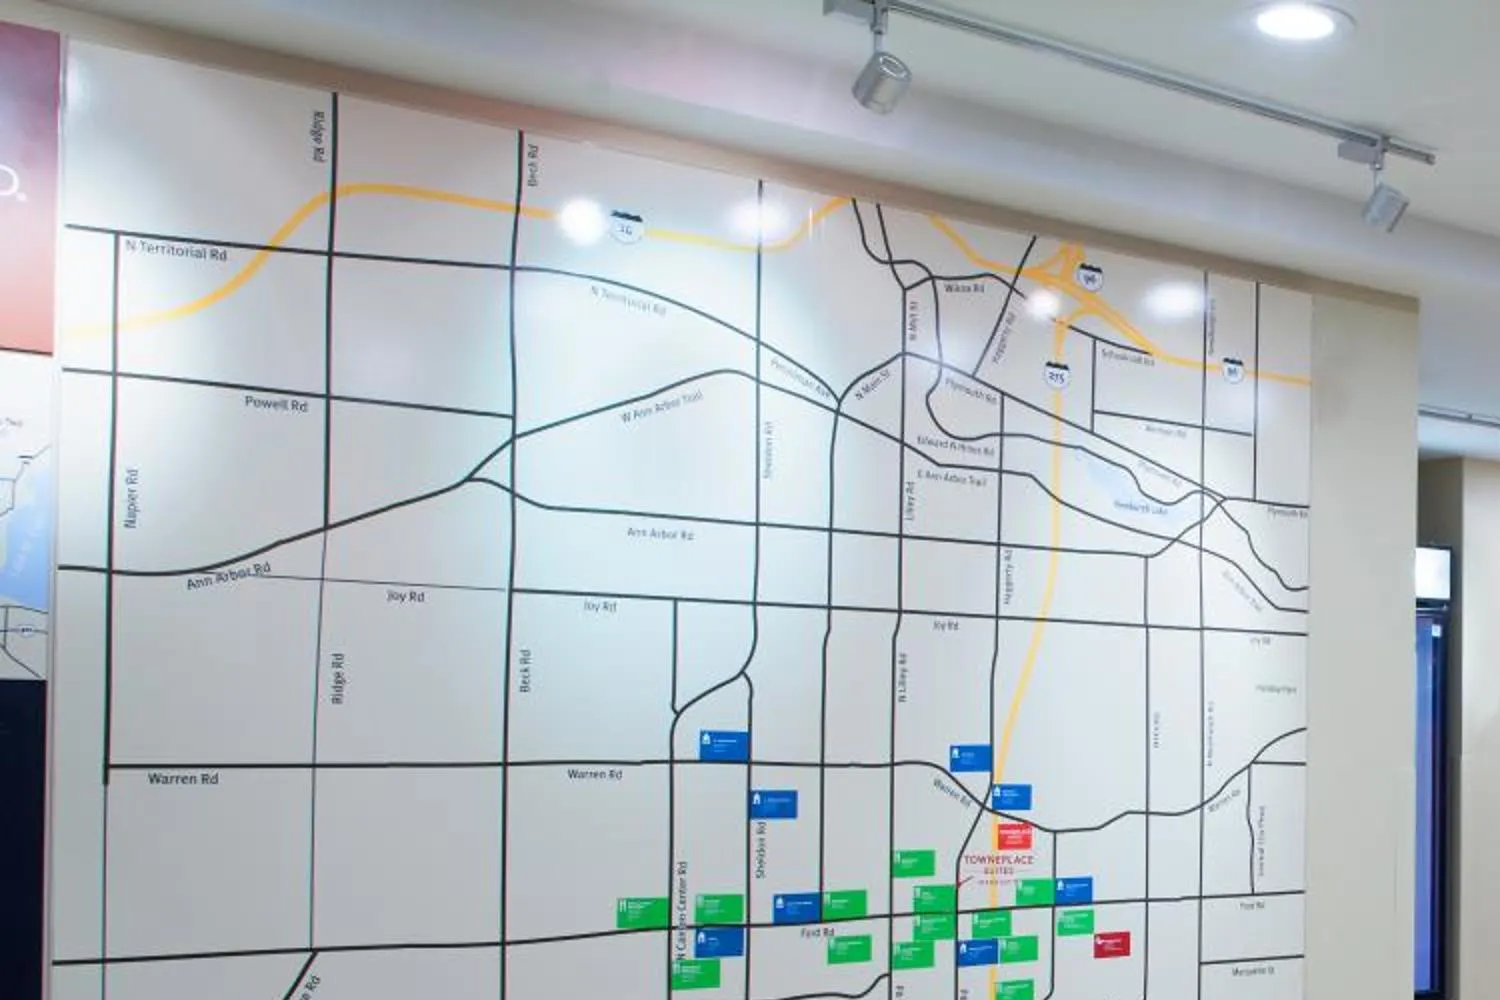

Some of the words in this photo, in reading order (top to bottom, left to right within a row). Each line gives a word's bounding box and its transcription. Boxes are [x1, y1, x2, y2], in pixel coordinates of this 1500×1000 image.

[126, 240, 136, 252] N
[140, 241, 207, 260] Territorial
[210, 249, 227, 262] Rd
[245, 396, 288, 411] Powell
[290, 400, 308, 413] Rd
[128, 469, 138, 485] Rd
[124, 486, 138, 529] Napier
[627, 527, 648, 538] Ann
[649, 528, 678, 540] Arbor
[187, 576, 213, 591] Ann
[215, 566, 251, 586] Arbor
[253, 562, 271, 577] Rd
[386, 590, 406, 604] Joy
[408, 592, 424, 602] Rd
[332, 652, 345, 669] Rd
[520, 649, 531, 665] Rd
[332, 670, 346, 705] Ridge
[520, 666, 530, 693] Beck
[148, 772, 196, 786] Warren
[201, 772, 219, 785] Rd
[568, 769, 606, 780] Warren
[608, 769, 623, 780] Rd
[964, 855, 1034, 864] TOWNEPLACE
[824, 928, 835, 938] Rd
[304, 975, 321, 994] Rd
